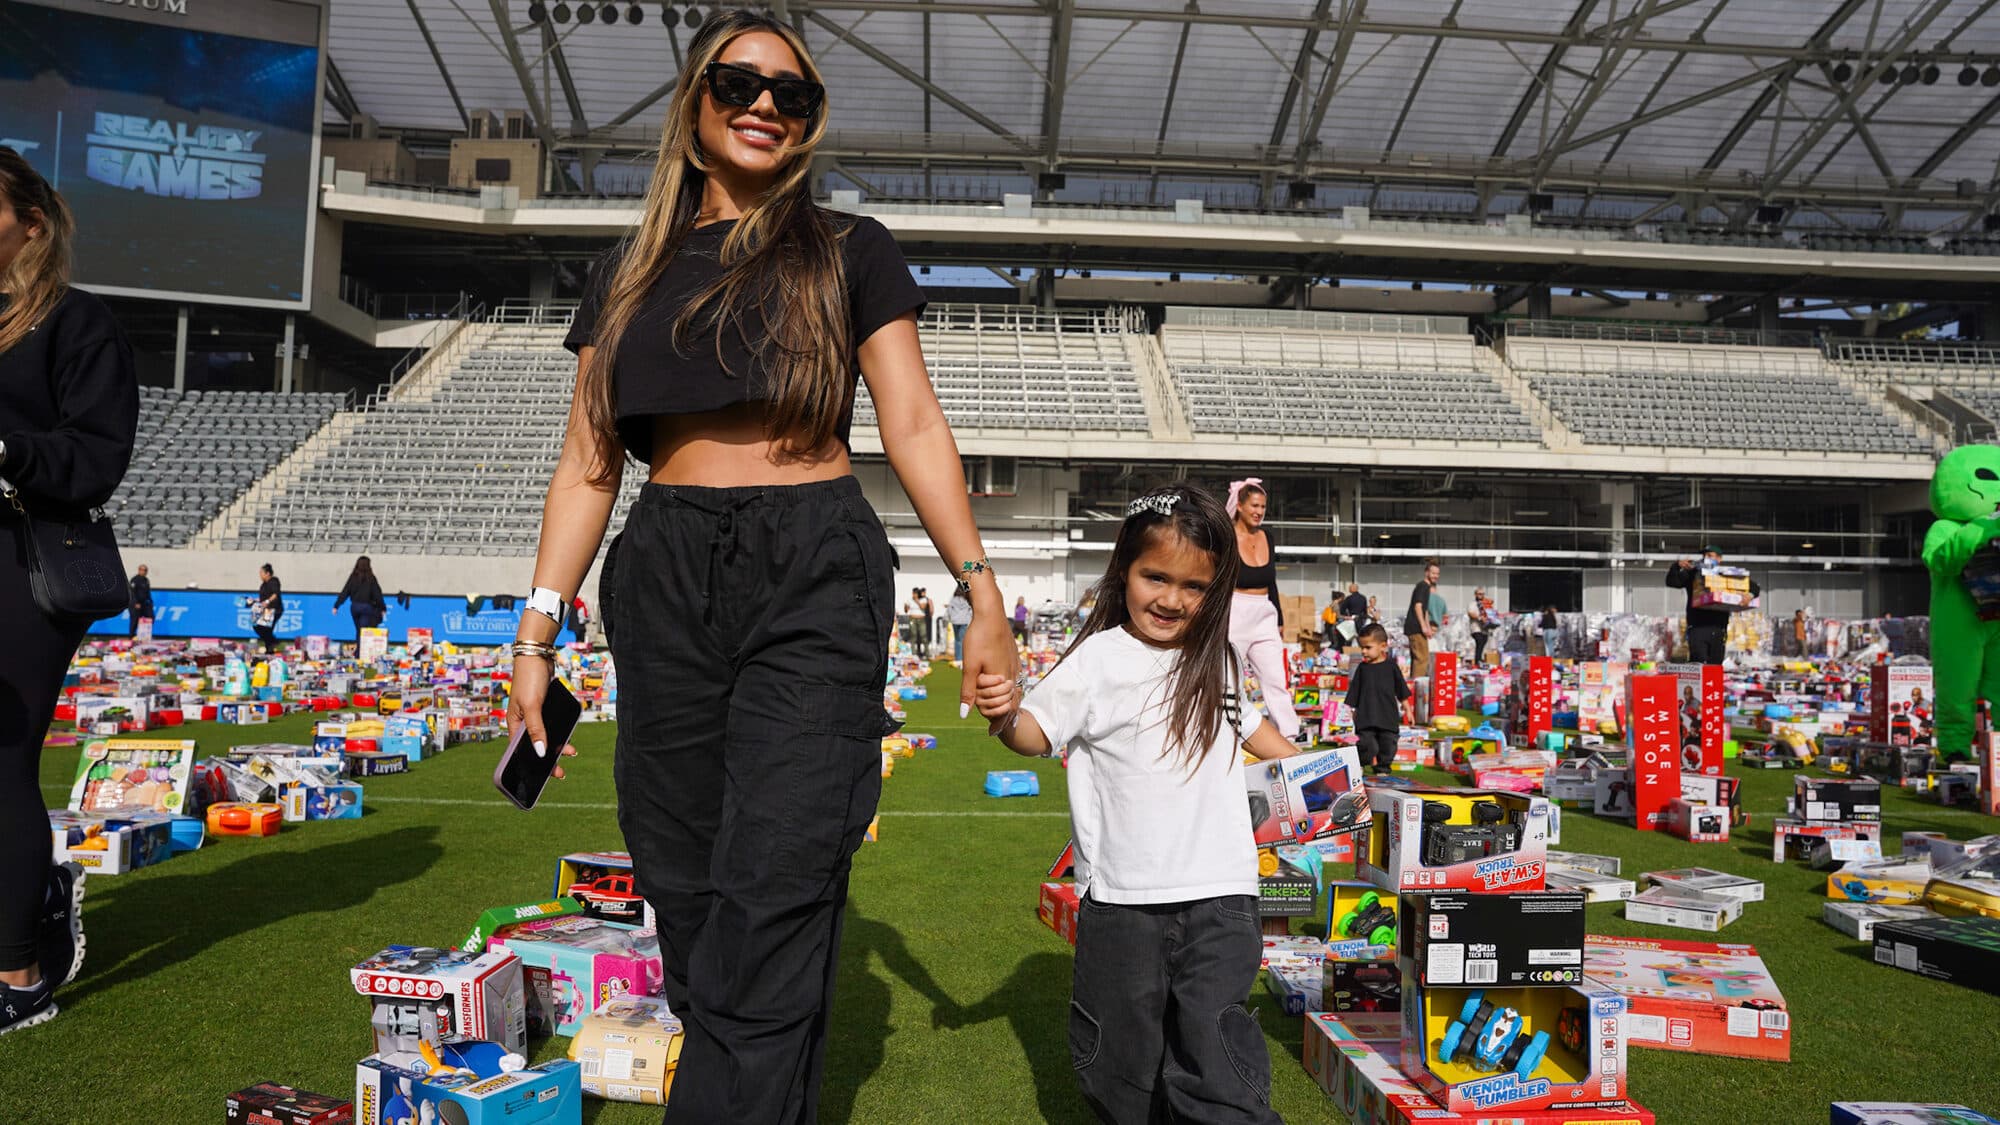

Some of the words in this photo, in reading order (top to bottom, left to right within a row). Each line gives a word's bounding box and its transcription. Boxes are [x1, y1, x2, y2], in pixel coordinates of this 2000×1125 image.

[94, 111, 263, 152] REALITY
[86, 146, 263, 200] GAMES
[238, 614, 303, 632] GES
[466, 622, 485, 631] TOY
[1439, 661, 1447, 707] TYSON
[1533, 669, 1541, 722] TYSON
[1705, 680, 1713, 747] TYSON
[1642, 695, 1658, 785] TYSON
[1658, 710, 1672, 769] MIKE
[1287, 751, 1339, 782] LAMBORGHINI
[1351, 778, 1361, 787] 6+
[1478, 857, 1514, 875] TRUCK
[1487, 861, 1541, 886] S.W.A.T.
[1258, 887, 1311, 897] TRIKER-X
[1331, 942, 1365, 951] VENOM
[1468, 943, 1497, 952] WORLD
[1468, 951, 1482, 959] TECH
[1483, 951, 1497, 959] TOYS
[461, 982, 473, 1037] RANSFORMERS
[1461, 1077, 1516, 1099] VENOM
[1475, 1082, 1548, 1108] TUMBLER
